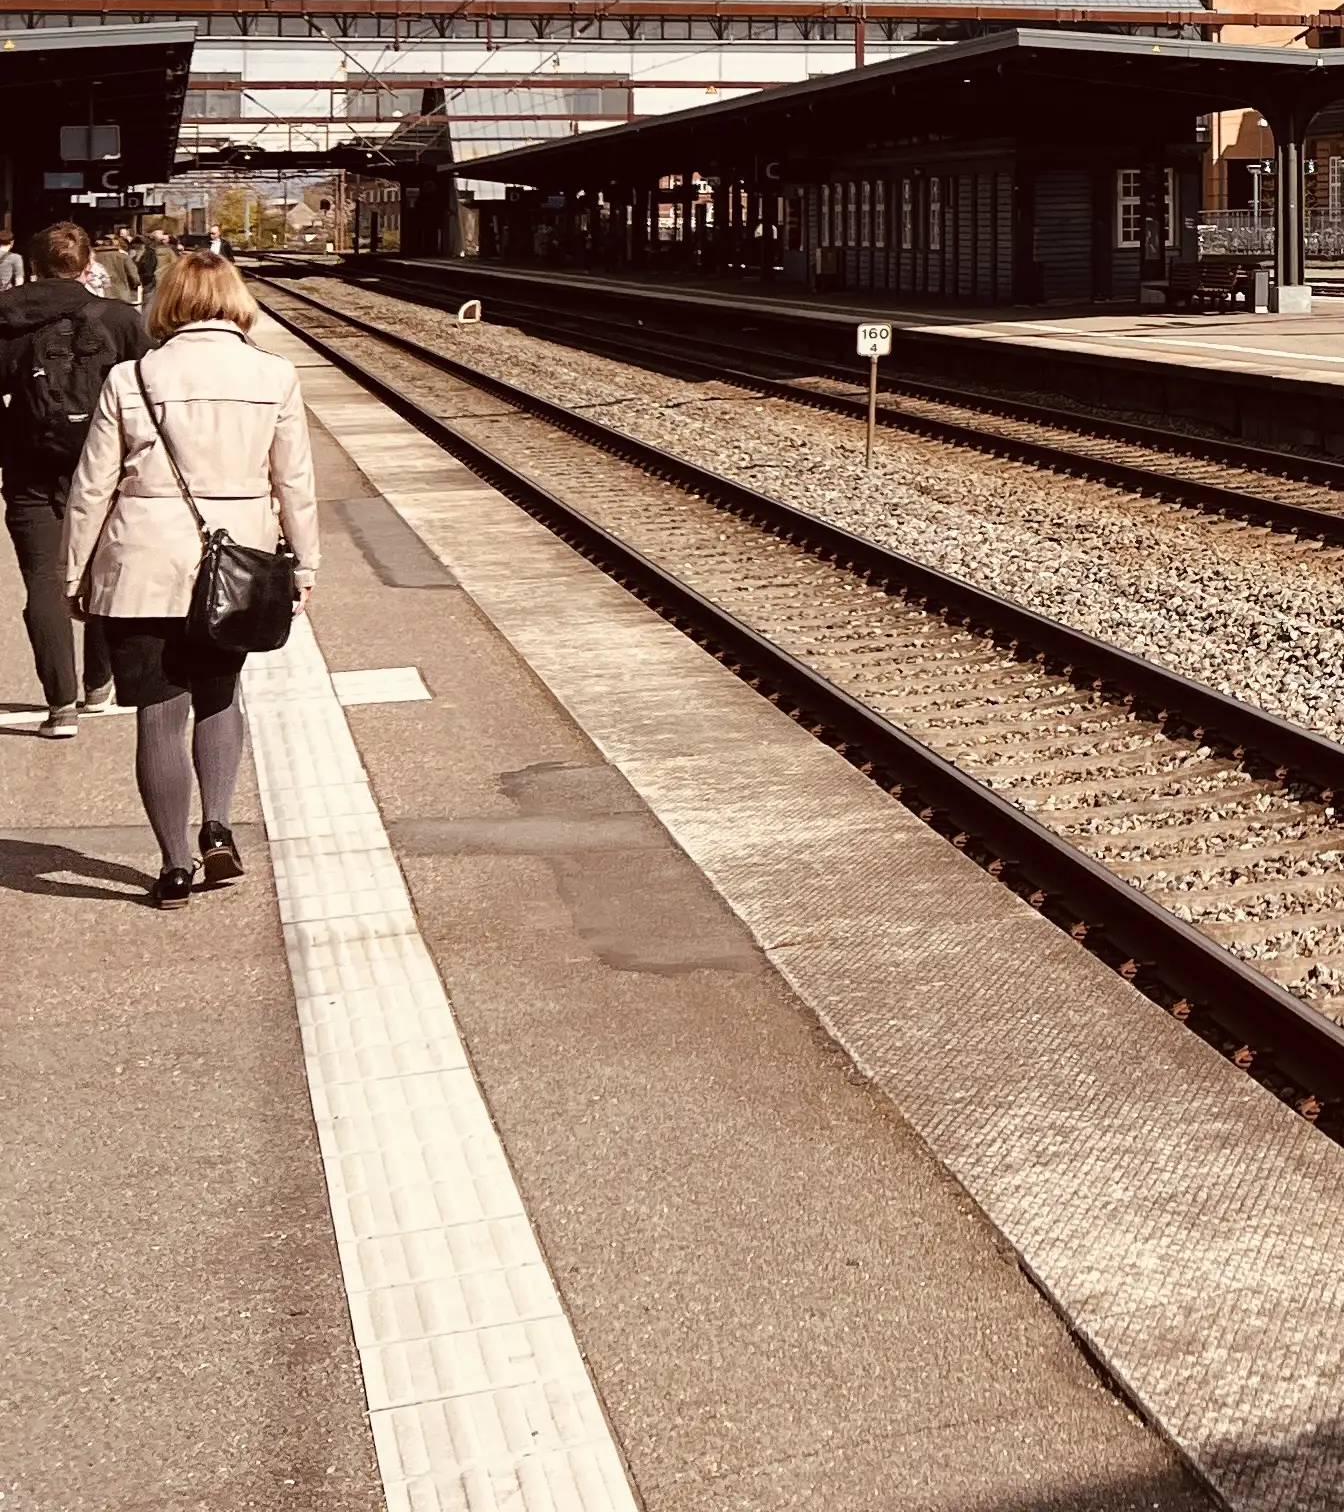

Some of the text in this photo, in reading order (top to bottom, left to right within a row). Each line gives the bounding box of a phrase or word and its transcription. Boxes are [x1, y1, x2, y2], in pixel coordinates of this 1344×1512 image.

[766, 162, 780, 179] C
[101, 170, 120, 189] C
[127, 197, 140, 208] D
[862, 328, 889, 339] 160
[869, 343, 878, 352] 4
